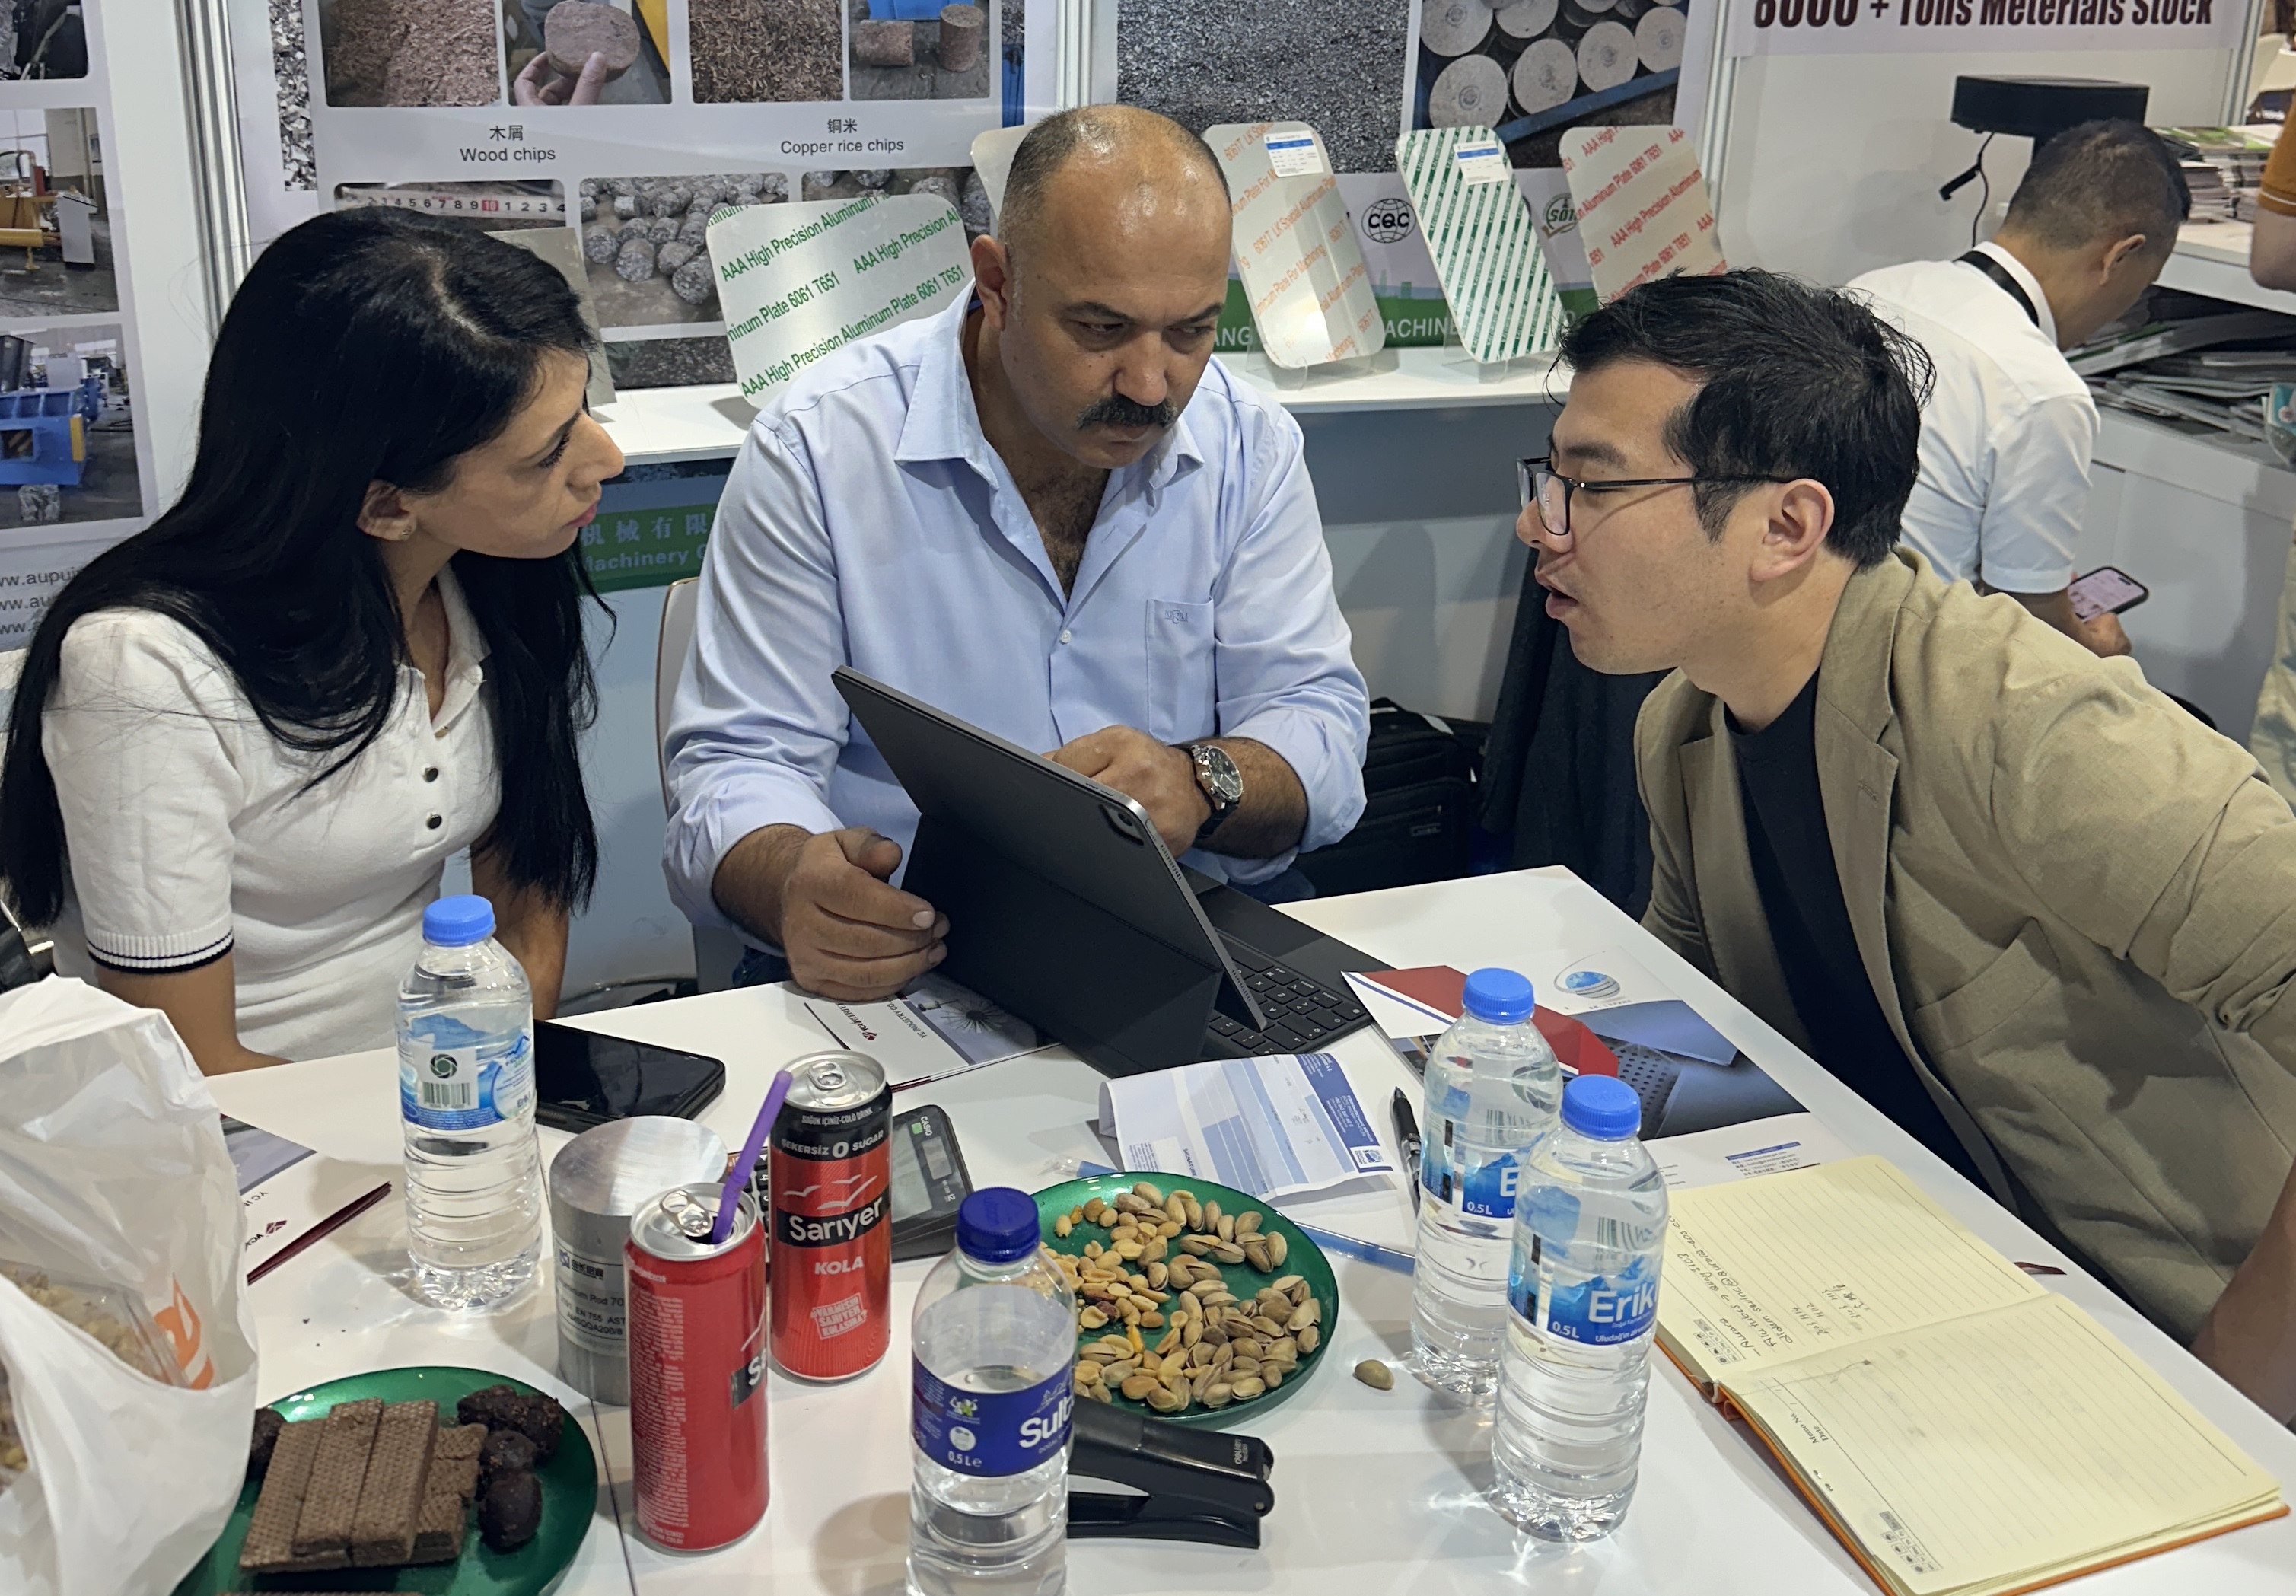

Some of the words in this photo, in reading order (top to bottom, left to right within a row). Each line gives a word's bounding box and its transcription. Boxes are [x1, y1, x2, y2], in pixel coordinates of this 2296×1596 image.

[489, 125, 524, 142] 木屑
[826, 118, 858, 135] 铜米
[460, 148, 508, 162] Wood
[513, 146, 556, 164] chips
[781, 140, 832, 158] Copper
[837, 139, 865, 154] rice
[868, 137, 905, 155] chips
[409, 198, 417, 207] 5
[424, 199, 431, 208] 6
[438, 200, 447, 209] 7
[454, 200, 463, 209] 8
[470, 200, 479, 210] 9
[505, 202, 511, 211] 1
[521, 202, 530, 212] 2
[538, 202, 547, 212] 3
[1368, 212, 1410, 229] CQC
[721, 257, 750, 282] AAA
[747, 246, 775, 272] High
[770, 221, 823, 255] Precision
[820, 197, 874, 231] Aluminum
[852, 251, 881, 275] AAA
[877, 239, 904, 263] High
[900, 219, 947, 247] Precision
[759, 301, 791, 327] Plate
[788, 284, 814, 309] 6061
[811, 270, 842, 295] T651
[740, 374, 769, 398] AAA
[767, 360, 795, 387] High
[791, 335, 843, 370] Precision
[840, 304, 894, 342] Aluminum
[889, 288, 919, 317] Plate
[916, 276, 943, 300] 6061
[938, 263, 966, 289] T651
[586, 548, 689, 571] achinery
[920, 1116, 933, 1136] CASIO
[832, 1141, 849, 1158] 0
[852, 1129, 884, 1152] SUGAR
[814, 1256, 865, 1276] KOLA
[1588, 1282, 1654, 1324] Erik
